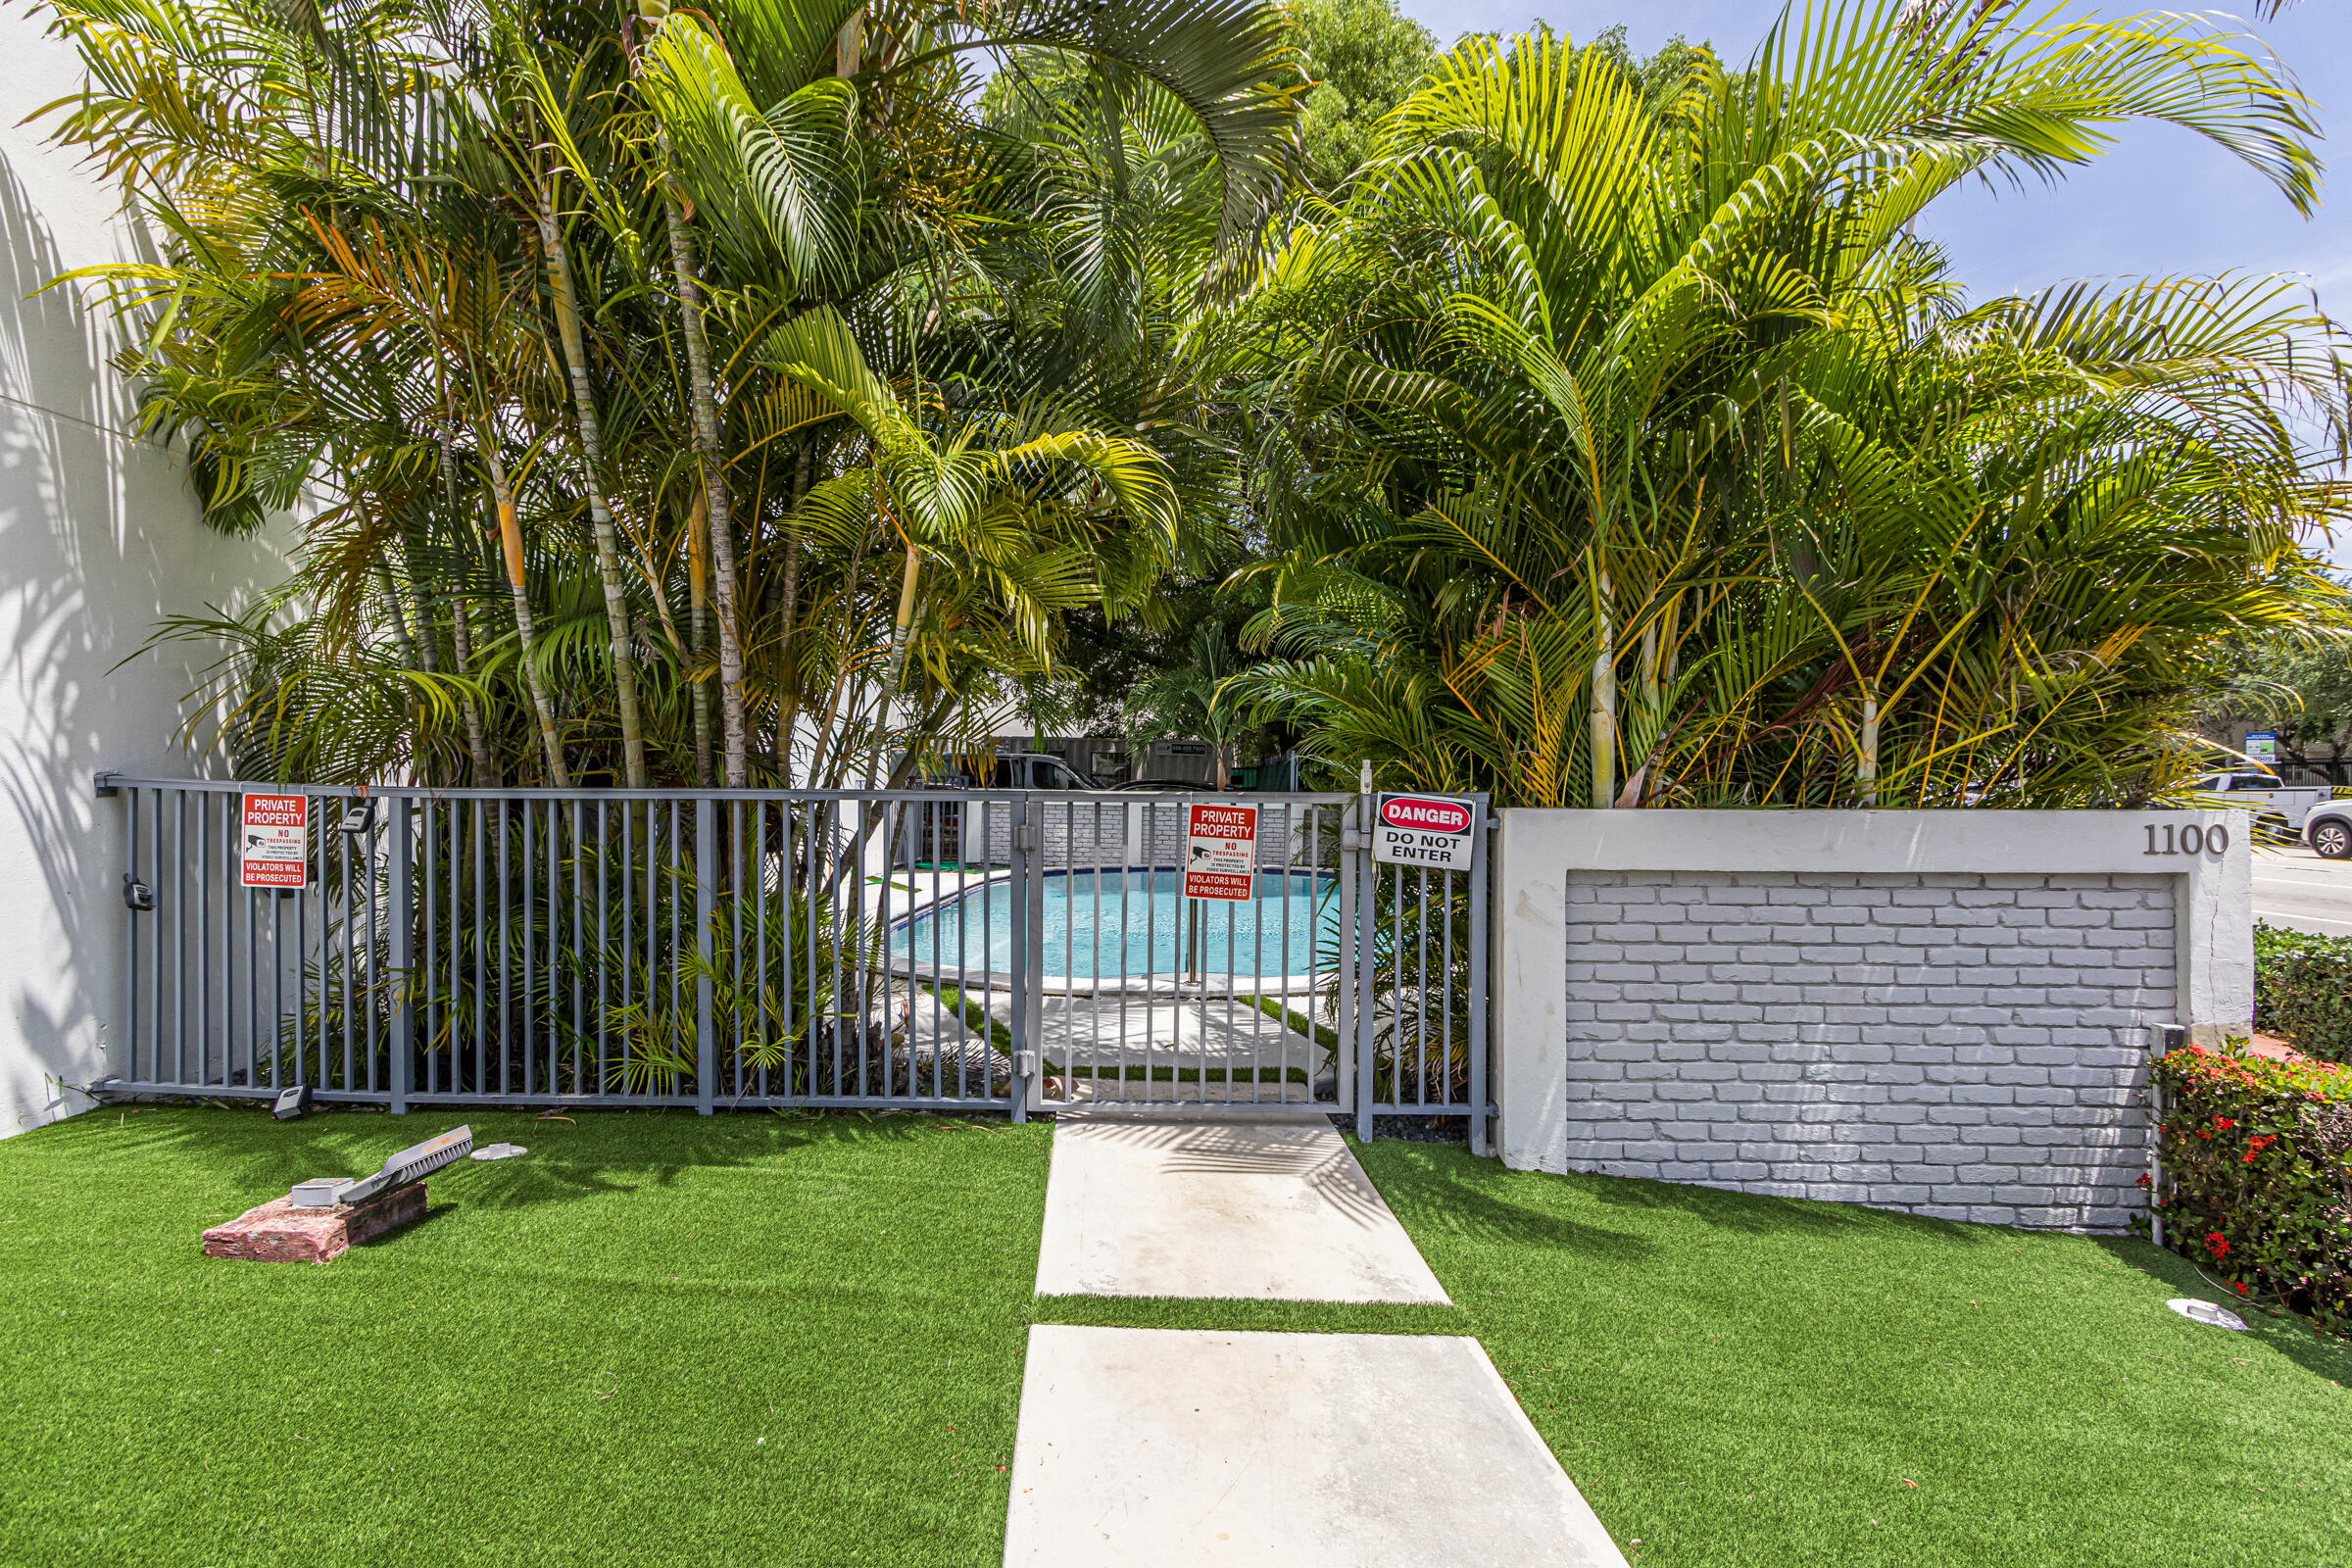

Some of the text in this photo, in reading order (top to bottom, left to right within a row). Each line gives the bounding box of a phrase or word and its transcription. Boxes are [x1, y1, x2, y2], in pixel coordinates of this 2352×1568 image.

[254, 799, 296, 811] PRIVATE
[247, 812, 303, 825] PROPERTY
[1200, 810, 1246, 824] PRIVATE
[1388, 805, 1464, 826] DANGER
[277, 829, 289, 838] NO
[1193, 823, 1251, 838] PROPERTY
[1386, 831, 1461, 850] DO NOT
[2143, 824, 2229, 855] 1100
[1225, 842, 1237, 851] NO
[1392, 846, 1452, 862] ENTER
[245, 862, 284, 871] VIOLATORS
[256, 873, 302, 883] PROSECUTED
[1189, 874, 1248, 886] VIOLATORS WILL
[1188, 885, 1248, 897] BE PROSECUTED
